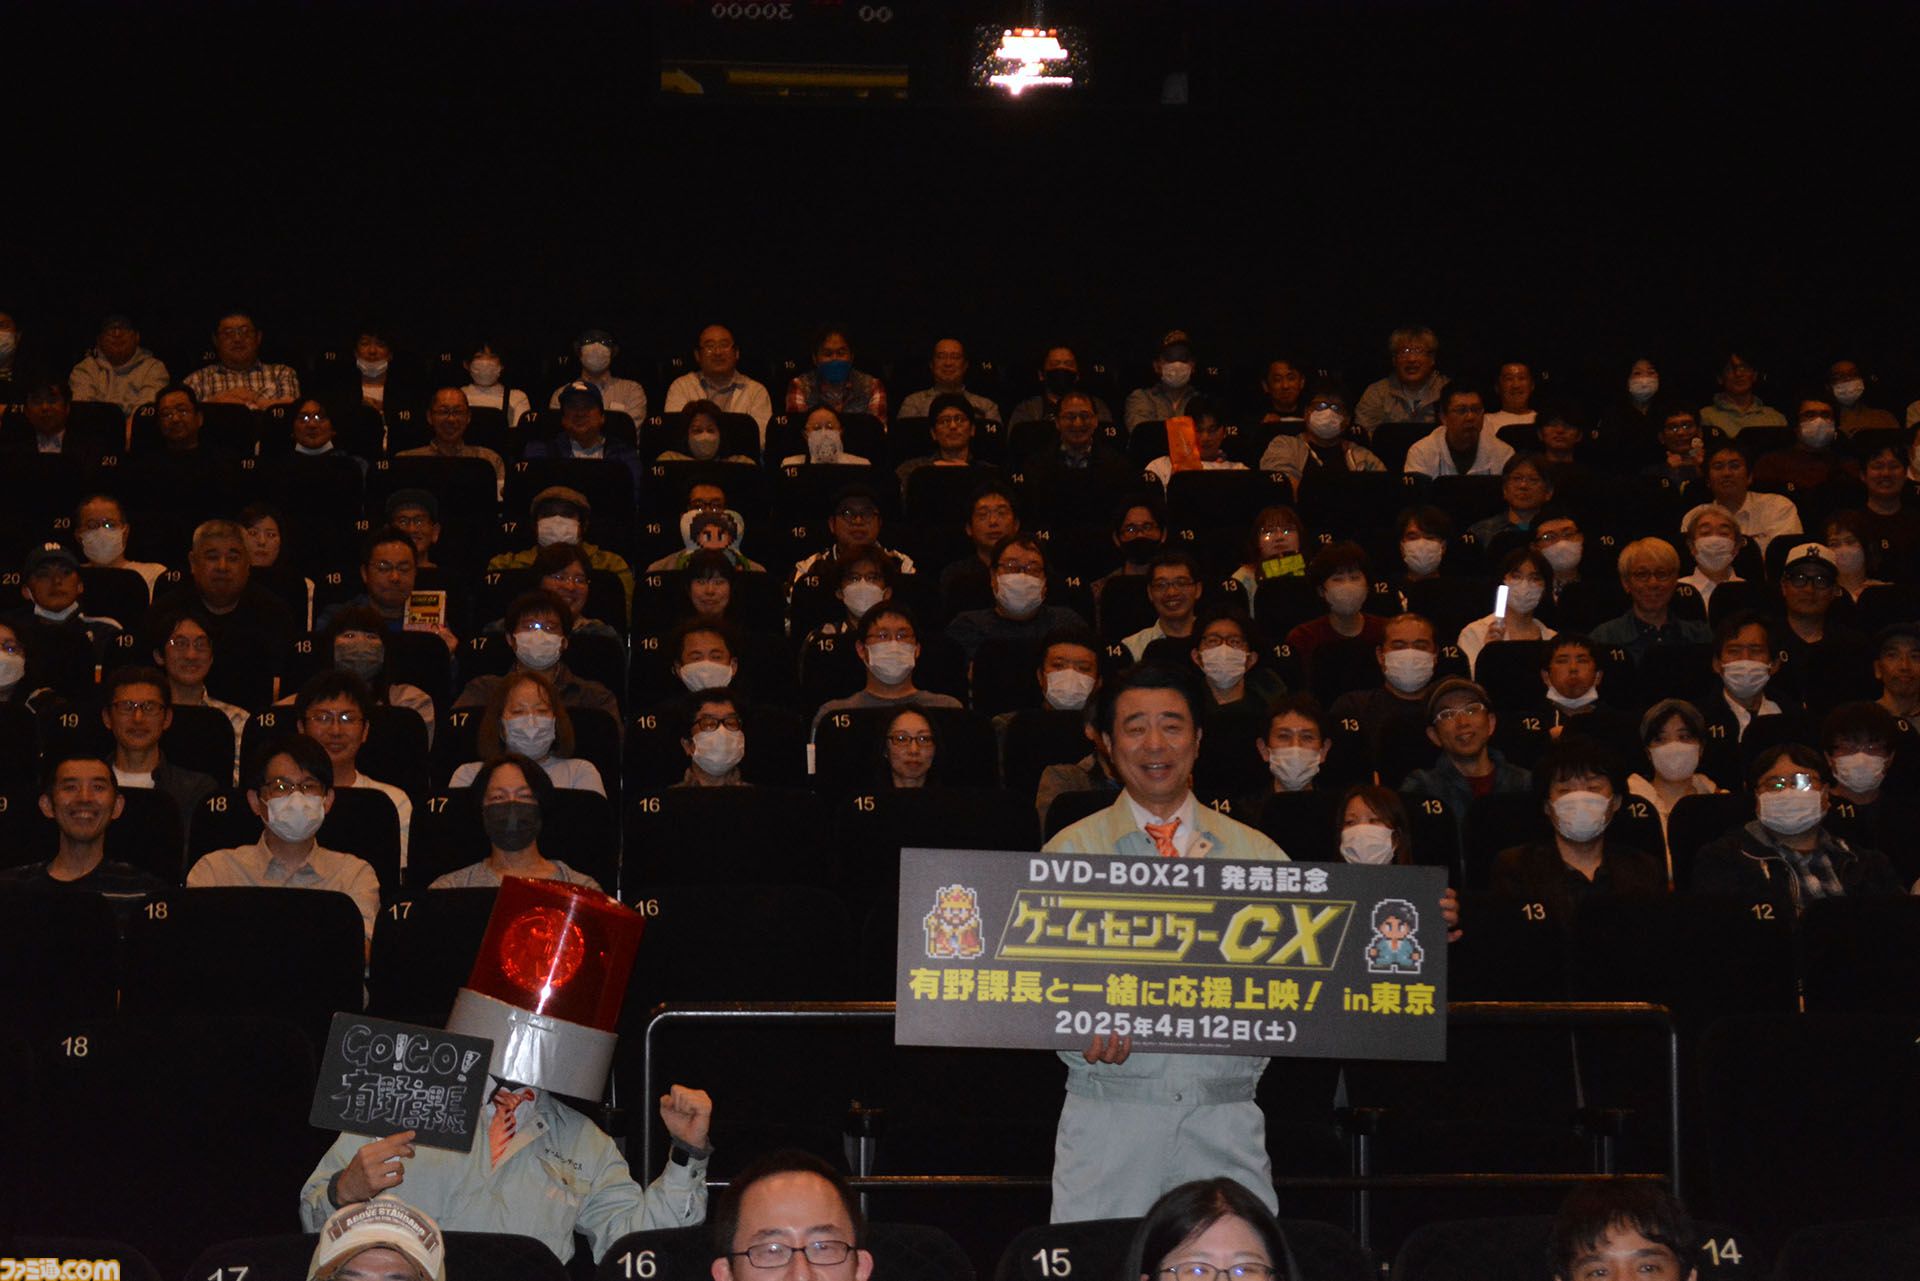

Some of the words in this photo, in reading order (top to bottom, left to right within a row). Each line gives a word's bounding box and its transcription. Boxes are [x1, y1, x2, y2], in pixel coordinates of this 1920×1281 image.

[557, 355, 569, 365] 17
[140, 406, 156, 417] 20
[271, 407, 285, 418] 19
[398, 409, 411, 421] 18
[525, 412, 538, 422] 17
[649, 415, 663, 426] 16
[775, 415, 789, 425] 15
[985, 423, 997, 433] 14
[1104, 426, 1117, 437] 13
[1225, 426, 1239, 436] 12
[1351, 425, 1362, 435] 11
[101, 455, 118, 467] 20
[240, 458, 256, 470] 19
[376, 459, 390, 471] 18
[514, 461, 529, 473] 17
[650, 465, 665, 477] 16
[785, 466, 798, 477] 15
[1143, 472, 1156, 482] 13
[1270, 472, 1284, 483] 12
[1011, 473, 1025, 484] 14
[1402, 475, 1415, 486] 11
[1660, 478, 1670, 489] 9
[53, 517, 71, 529] 20
[355, 519, 369, 531] 18
[502, 521, 517, 533] 17
[645, 522, 661, 535] 16
[791, 526, 807, 538] 15
[1035, 530, 1050, 541] 14
[1179, 529, 1195, 541] 13
[1461, 533, 1475, 544] 11
[1318, 533, 1333, 546] 12
[1599, 535, 1615, 546] 10
[2, 572, 21, 585] 20
[165, 571, 181, 582] 19
[326, 572, 342, 585] 18
[484, 572, 502, 585] 17
[645, 575, 662, 588] 16
[803, 575, 820, 587] 15
[1065, 576, 1081, 587] 14
[1222, 579, 1238, 591] 13
[1374, 581, 1389, 594] 12
[1678, 586, 1693, 596] 10
[115, 634, 134, 648] 19
[295, 640, 311, 653] 18
[470, 636, 488, 650] 17
[641, 637, 659, 650] 16
[817, 638, 834, 652] 15
[1106, 644, 1123, 657] 14
[1273, 644, 1291, 658] 13
[1442, 646, 1458, 658] 12
[1609, 648, 1625, 661] 11
[1778, 650, 1789, 663] 0
[60, 714, 78, 727] 19
[257, 713, 275, 726] 18
[450, 713, 468, 726] 17
[637, 715, 657, 729] 16
[832, 714, 850, 727] 15
[1340, 718, 1360, 732] 13
[1522, 717, 1541, 731] 12
[1897, 718, 1910, 732] 0
[1709, 725, 1724, 738] 11
[0, 797, 7, 812] 9
[207, 797, 227, 812] 18
[428, 797, 448, 812] 17
[640, 798, 660, 812] 16
[854, 796, 874, 811] 15
[1211, 799, 1232, 812] 14
[1422, 800, 1442, 814] 13
[1629, 803, 1648, 817] 12
[1837, 804, 1854, 817] 11
[1029, 858, 1205, 888] DVD-BOX21
[1221, 865, 1329, 893] 発売記念
[145, 902, 167, 919] 18
[389, 902, 412, 920] 17
[636, 899, 658, 917] 16
[1522, 903, 1545, 920] 13
[1752, 904, 1775, 919] 12
[1002, 896, 1347, 966] ゲームセンターCX
[909, 968, 1323, 1011] 有野課長と一緒に応援上映！
[1343, 982, 1436, 1015] in東京
[1055, 1010, 1297, 1042] 2025年4月12日(土)
[62, 1037, 88, 1056] 18
[346, 1208, 377, 1227] ABOVE
[378, 1207, 426, 1236] STANDARD
[1702, 1237, 1742, 1266] 14
[617, 1251, 656, 1279] 16
[1032, 1247, 1071, 1277] 15
